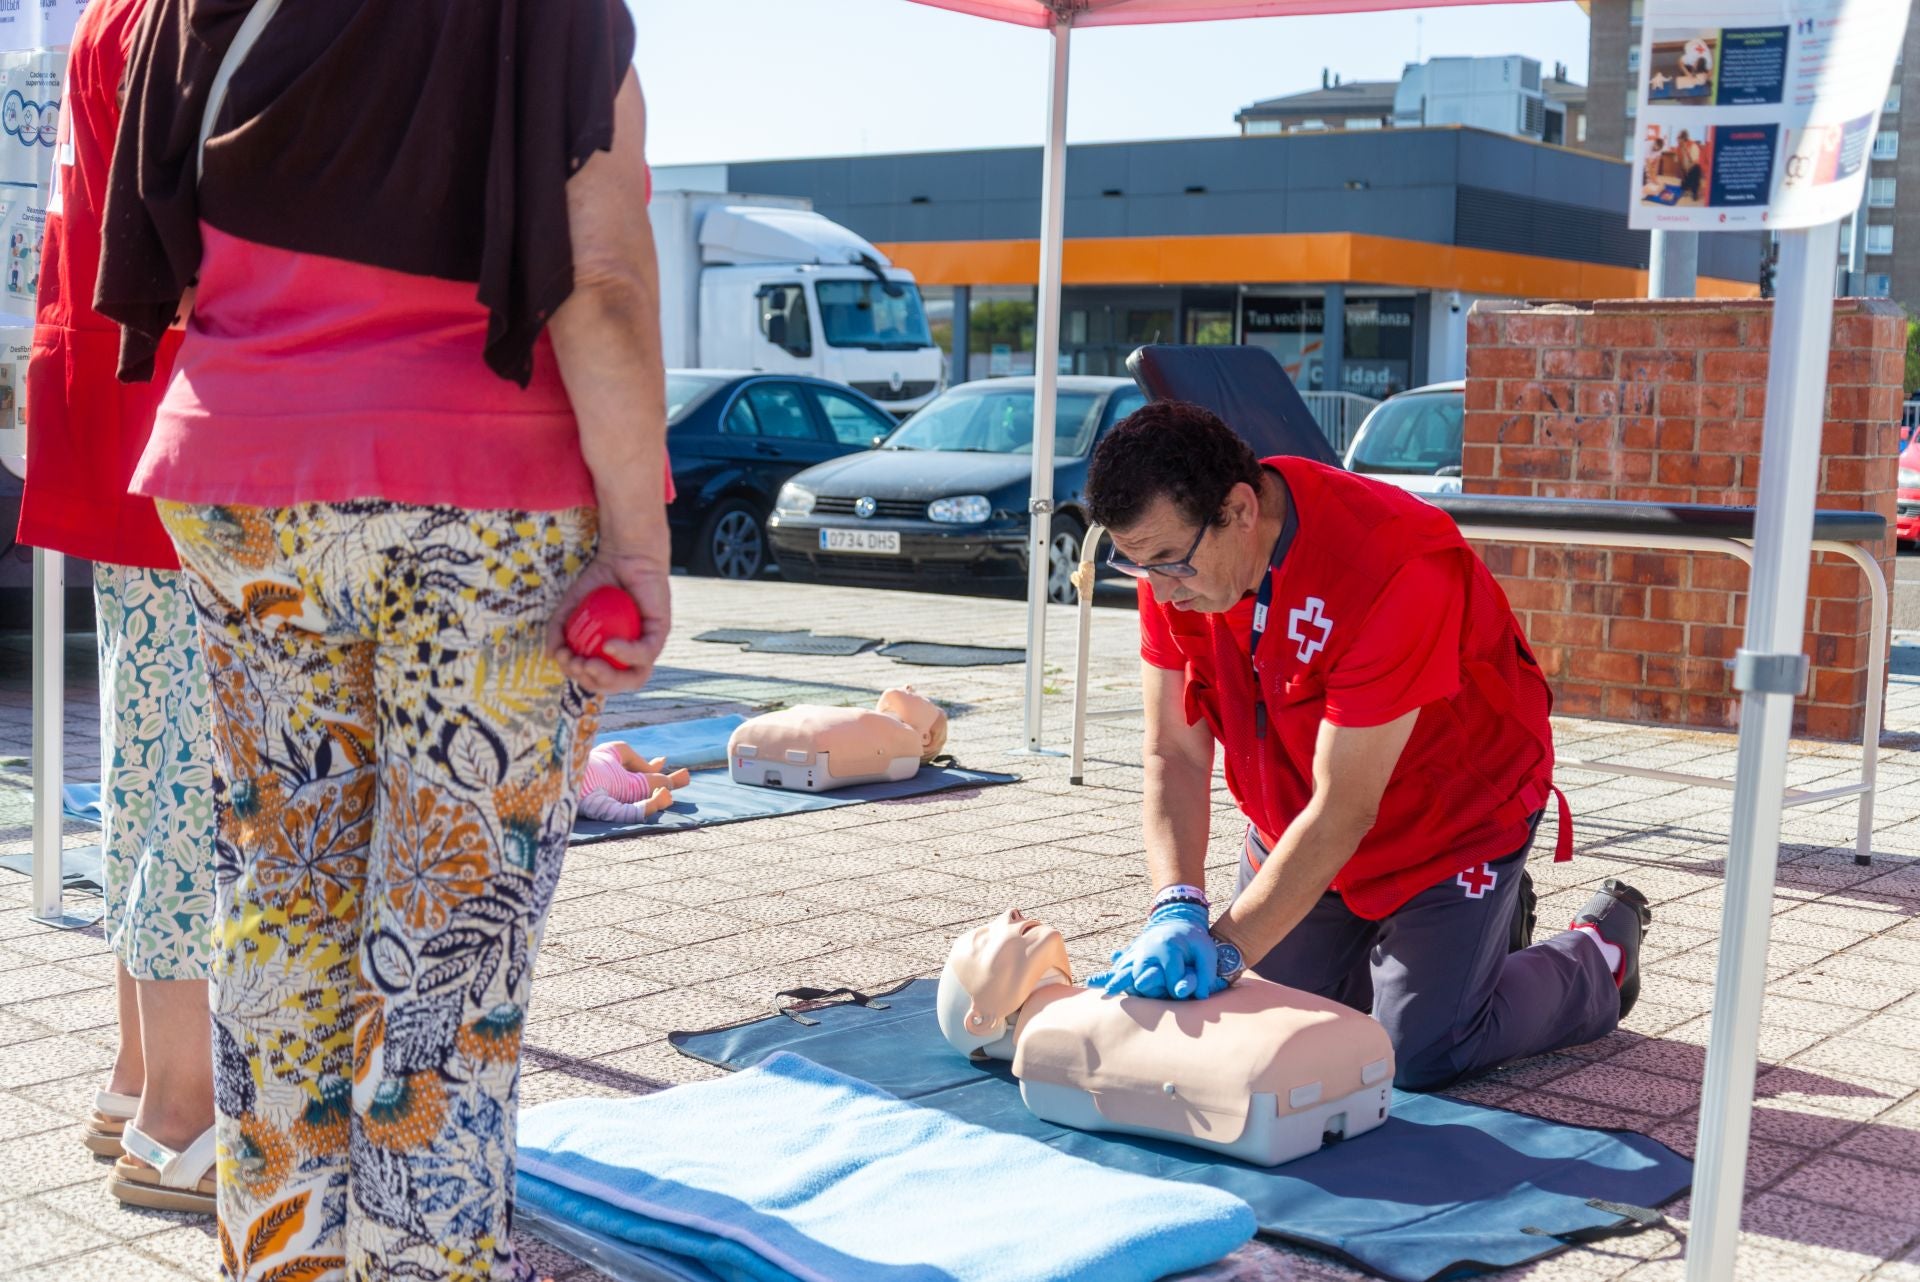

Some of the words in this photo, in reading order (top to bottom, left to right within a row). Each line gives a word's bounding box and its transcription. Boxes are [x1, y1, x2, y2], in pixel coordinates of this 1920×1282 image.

[50, 71, 57, 79] de
[1248, 310, 1271, 326] Tus
[1274, 311, 1323, 327] vecinos
[1311, 366, 1389, 383] Cidad
[830, 533, 863, 548] 0734
[868, 534, 896, 550] DHS
